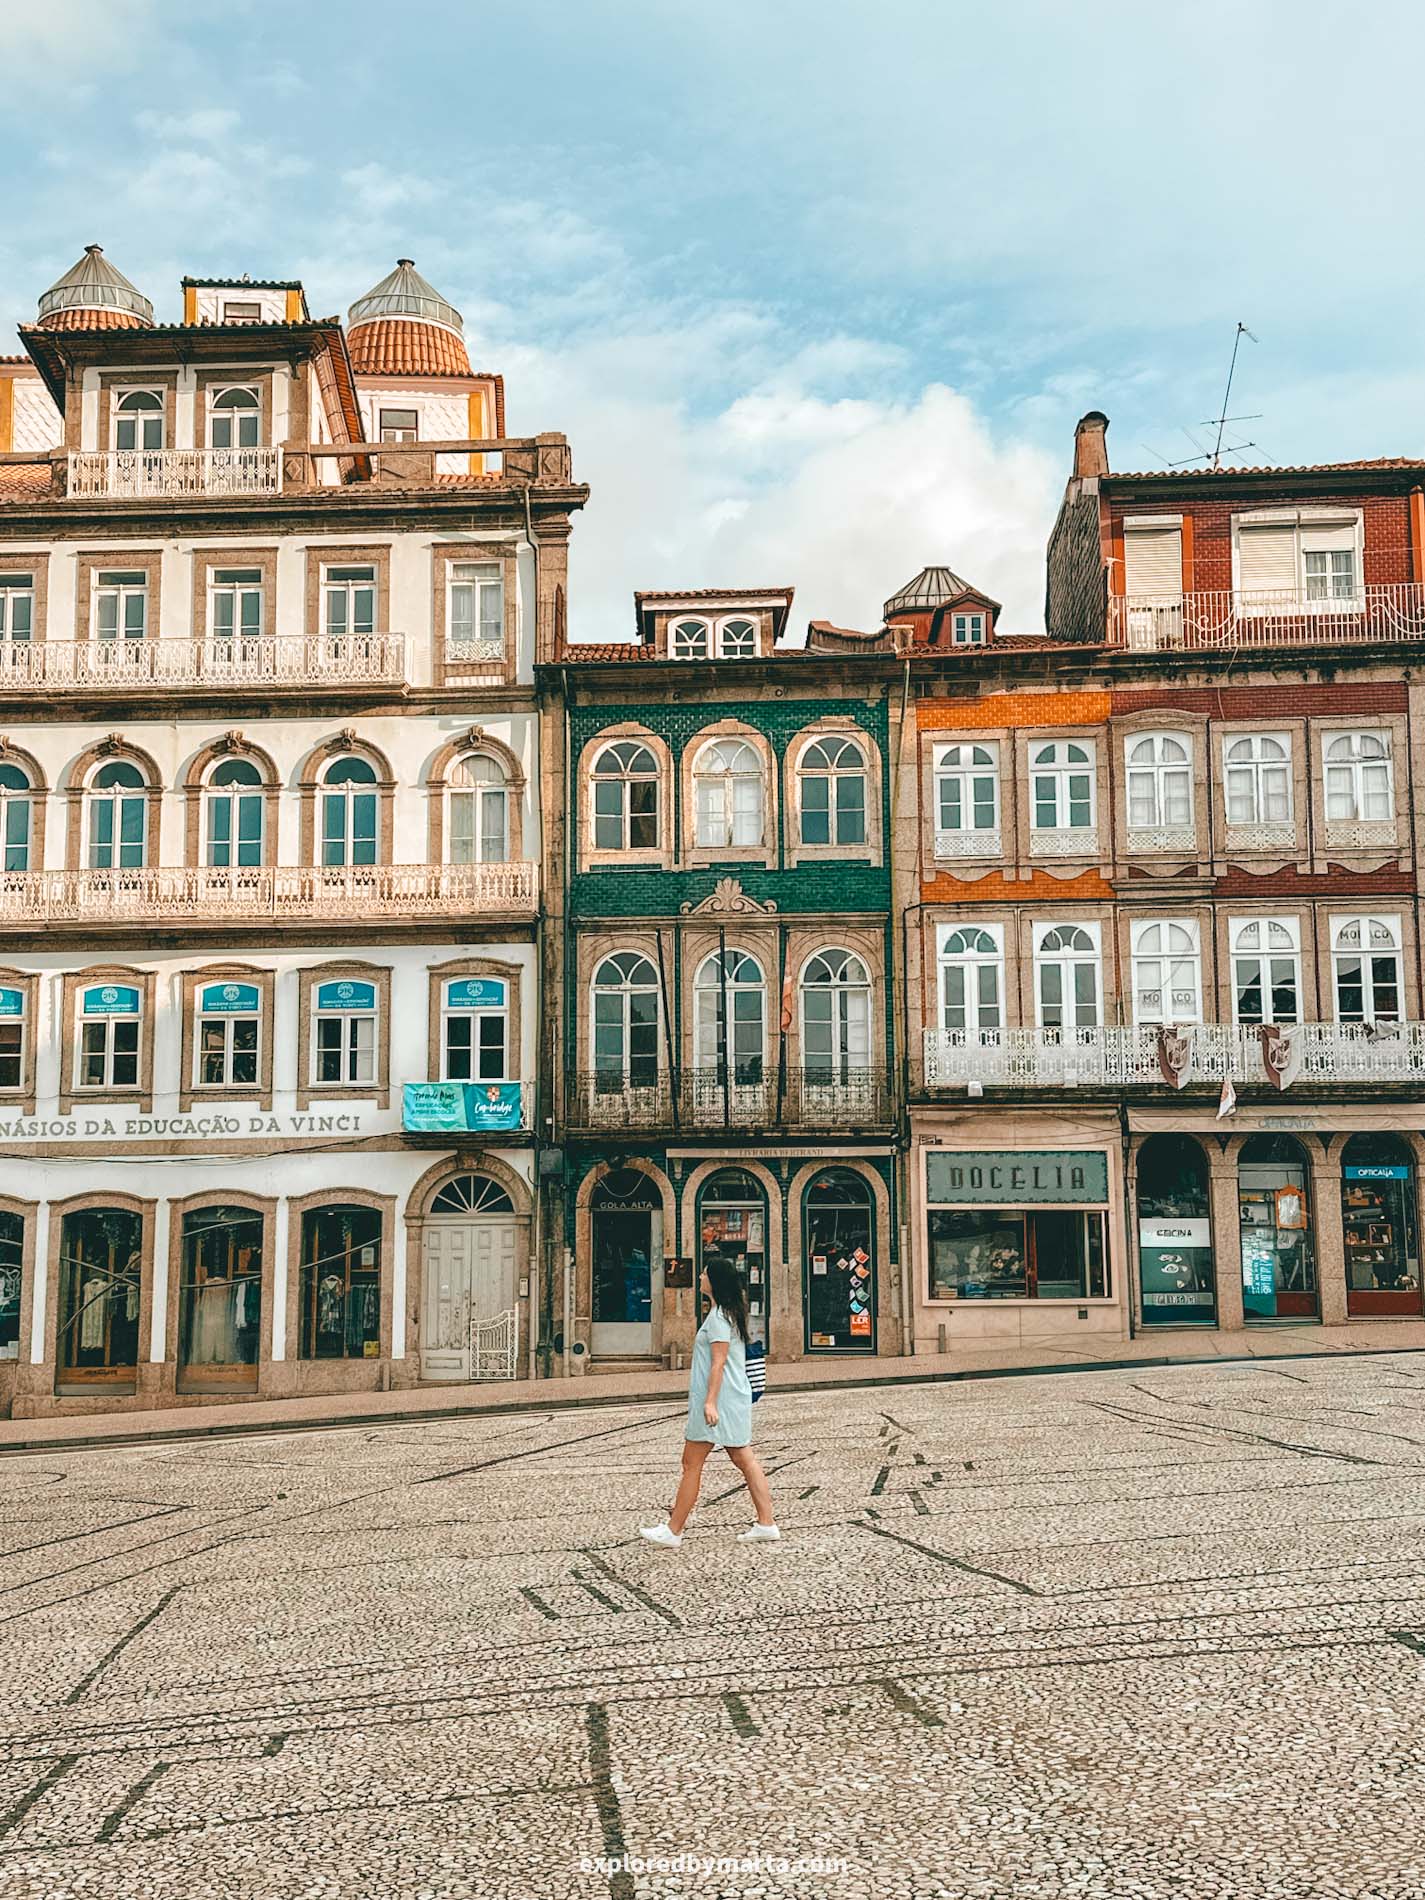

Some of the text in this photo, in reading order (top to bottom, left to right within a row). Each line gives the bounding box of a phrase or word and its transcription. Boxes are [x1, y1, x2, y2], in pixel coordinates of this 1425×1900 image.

[0, 1118, 77, 1136] NÁSIOS
[125, 1115, 240, 1137] EDUCAÇÃO
[250, 1117, 281, 1132] DA
[290, 1115, 360, 1131] VINCI
[950, 1165, 1085, 1190] DOCELIA
[600, 1201, 654, 1209] GOLA ALTA
